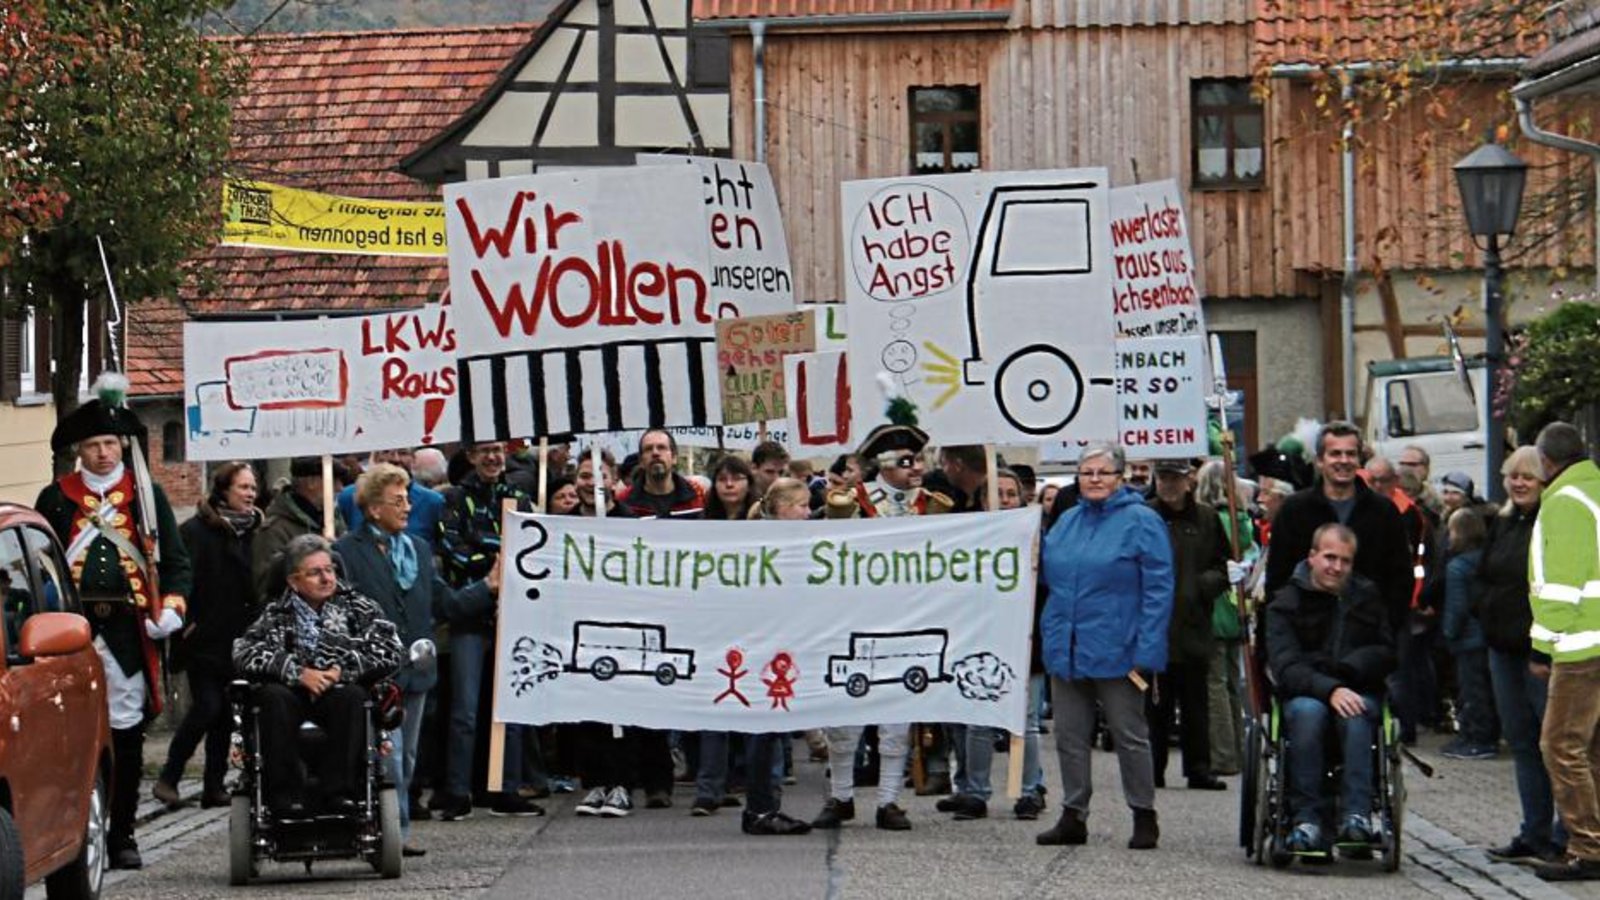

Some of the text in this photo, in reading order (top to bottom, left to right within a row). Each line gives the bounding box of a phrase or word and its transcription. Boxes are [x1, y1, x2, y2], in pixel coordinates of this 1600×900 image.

[456, 191, 582, 259] Wir
[868, 191, 932, 230] ICH
[862, 229, 951, 263] habe
[471, 239, 712, 338] Wollen
[869, 253, 955, 297] Angst
[361, 310, 457, 356] LKWs
[382, 357, 457, 400] Raus
[1153, 428, 1194, 445] SEIN
[562, 532, 782, 590] Naturpark
[806, 539, 1019, 592] Stromberg
